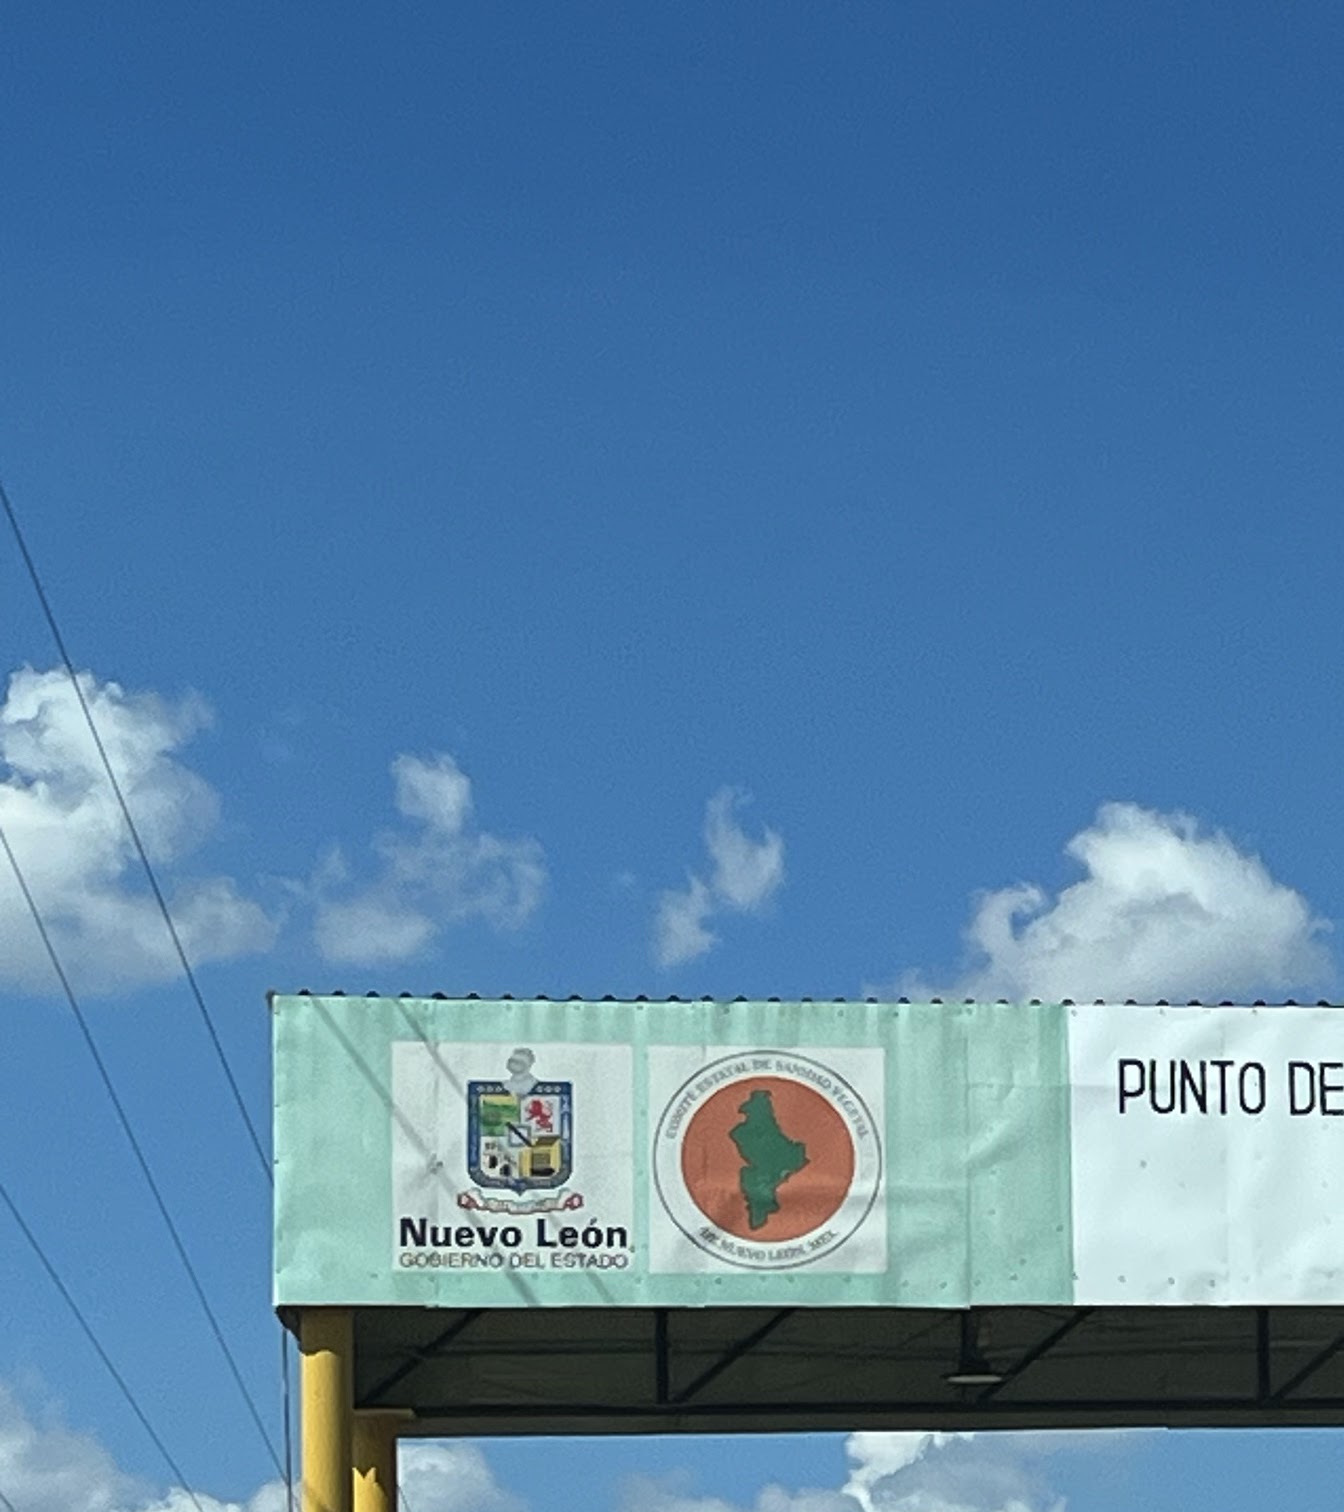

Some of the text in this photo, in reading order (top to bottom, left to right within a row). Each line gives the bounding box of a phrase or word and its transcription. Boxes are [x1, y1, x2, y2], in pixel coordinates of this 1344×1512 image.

[697, 1062, 747, 1092] ESTATAL
[752, 1059, 772, 1070] DE
[1118, 1058, 1266, 1114] PUNTO
[1288, 1062, 1344, 1116] DE
[400, 1217, 628, 1248] Nuevo León
[400, 1252, 628, 1269] GOBIERNO DEL ESTADO
